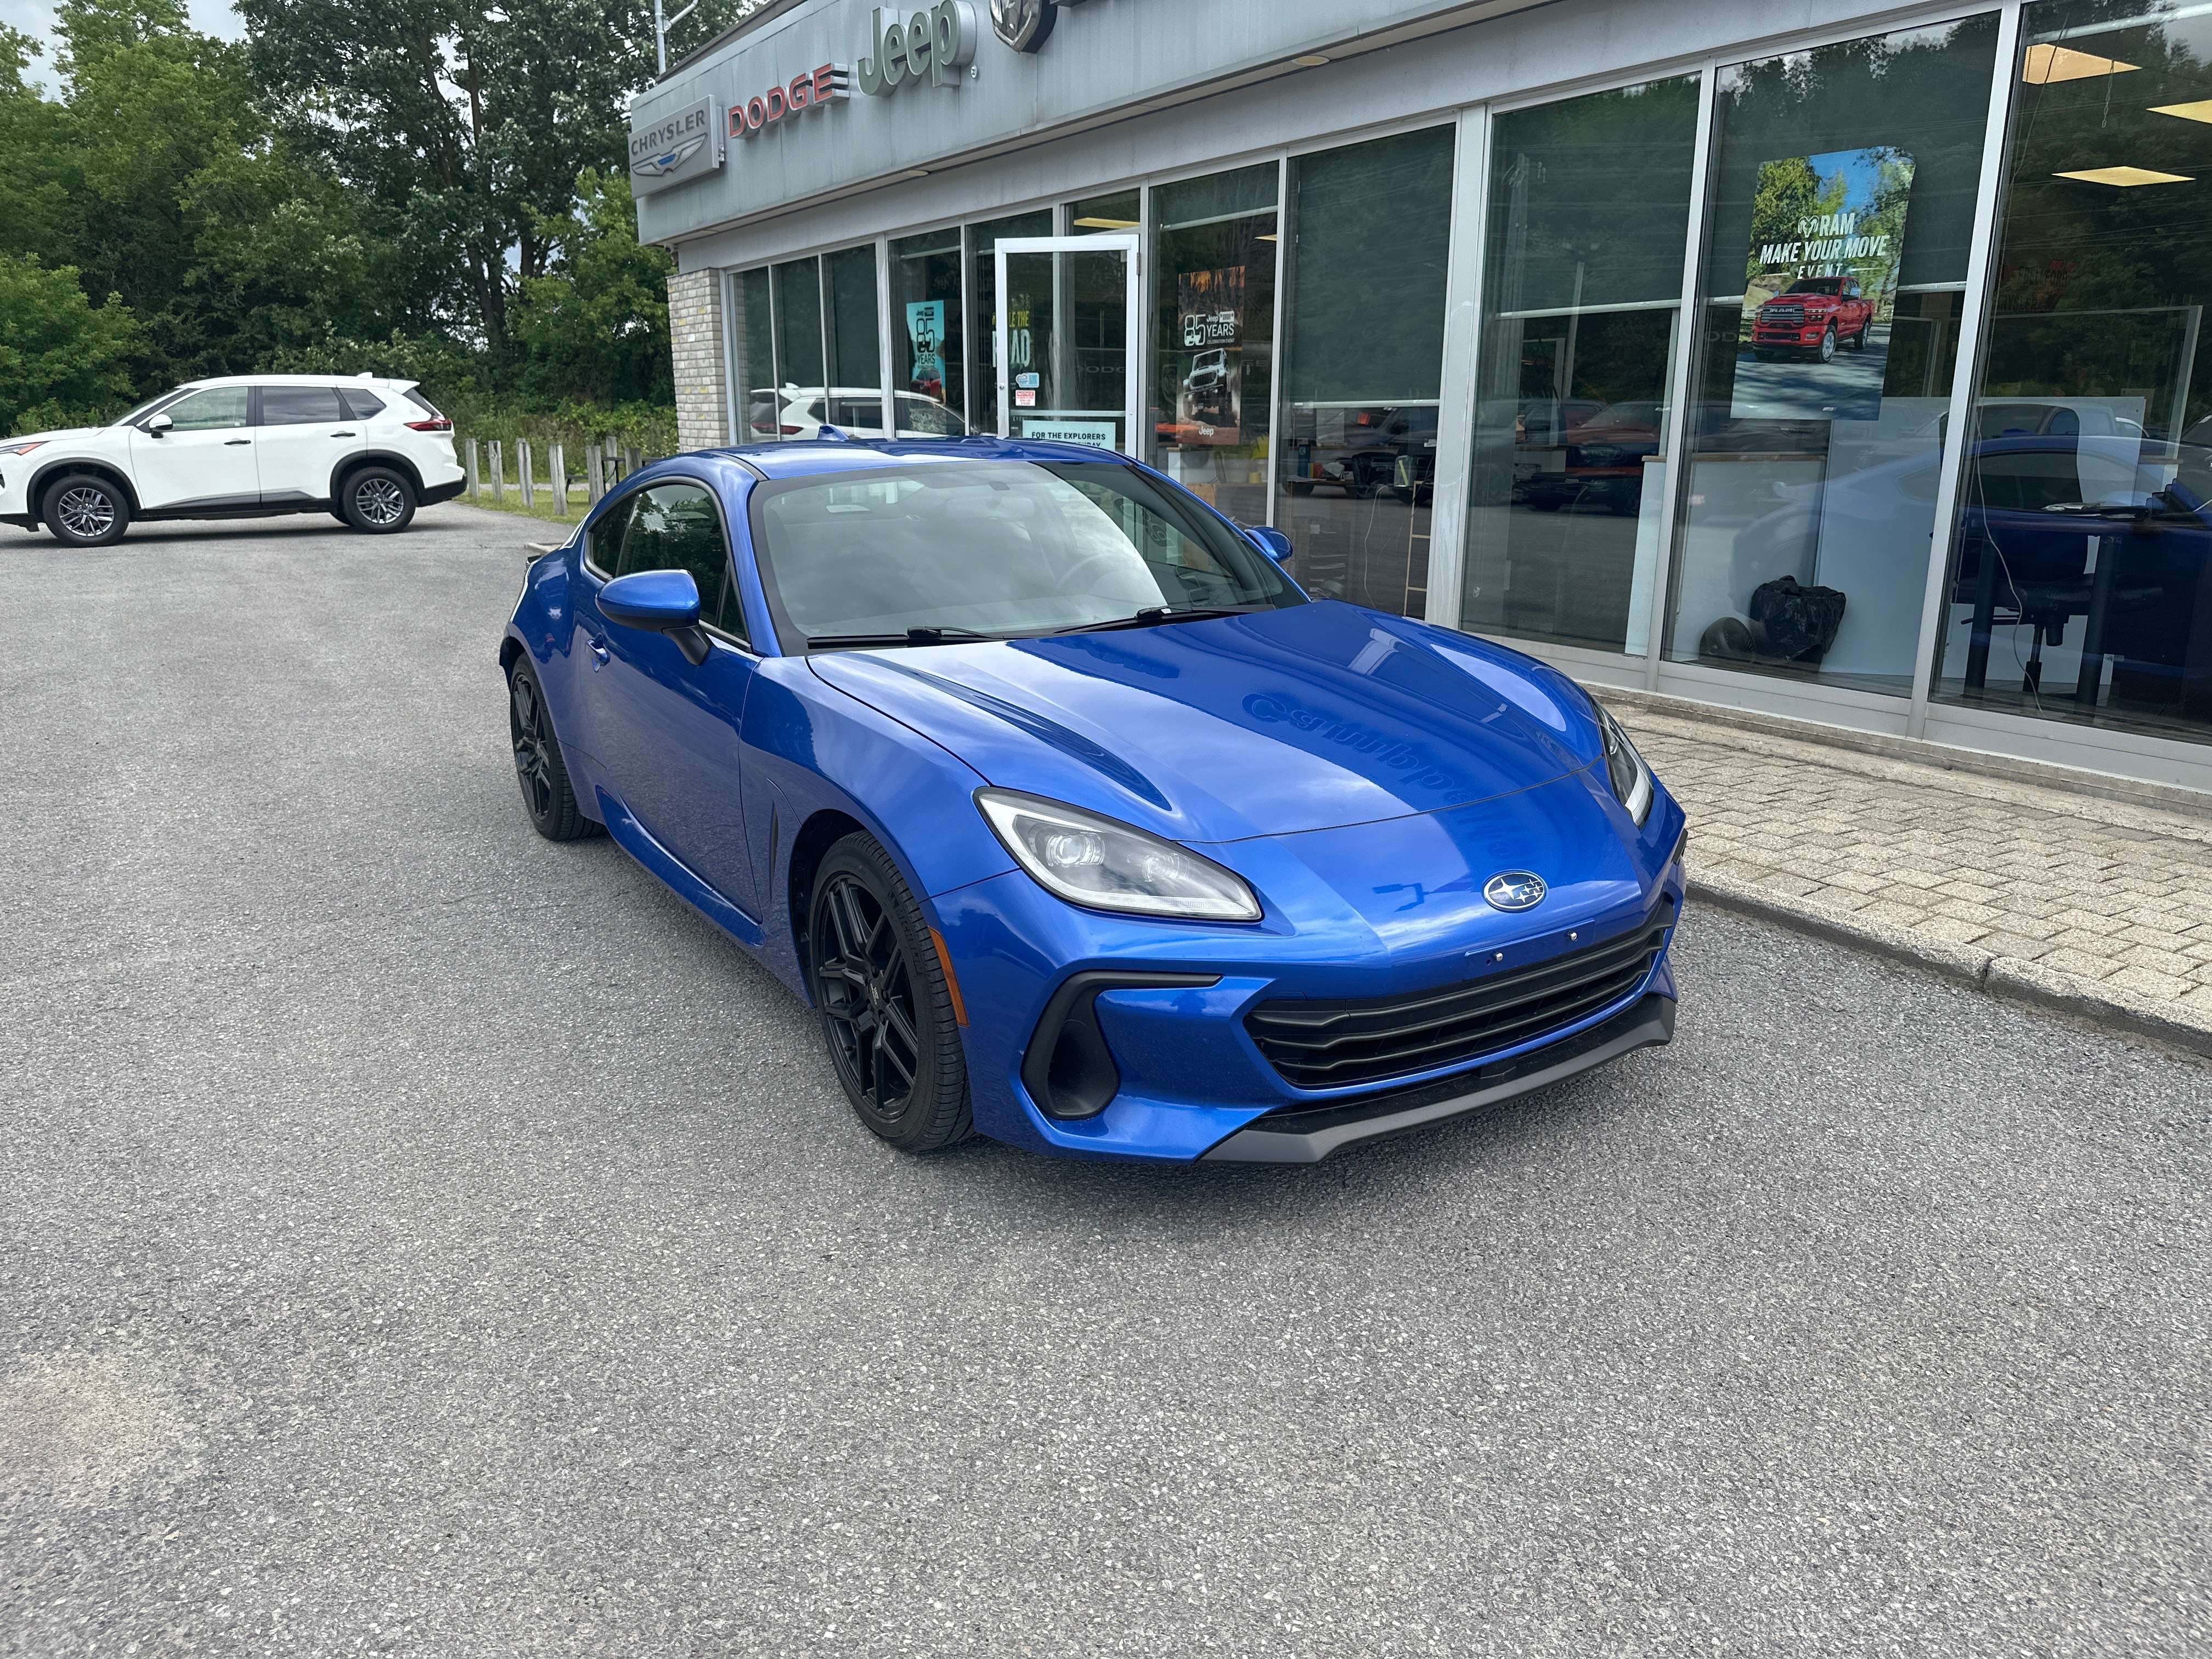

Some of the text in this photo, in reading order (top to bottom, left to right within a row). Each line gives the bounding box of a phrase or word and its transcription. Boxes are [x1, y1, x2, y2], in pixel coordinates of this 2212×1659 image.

[857, 0, 974, 96] Jeep
[728, 63, 848, 138] DODGE
[631, 110, 706, 156] CHRYSLER
[1819, 212, 1855, 236] RAM
[1759, 235, 1890, 264] MAKE YOUR MOVE
[1797, 263, 1843, 280] EVENT
[1017, 311, 1029, 327] THE
[1184, 314, 1206, 346] 85
[1206, 314, 1219, 323] Jeep
[1206, 323, 1234, 337] YEARS
[917, 318, 935, 353] 85
[917, 354, 935, 364] YEARS
[1199, 426, 1214, 437] Jeep
